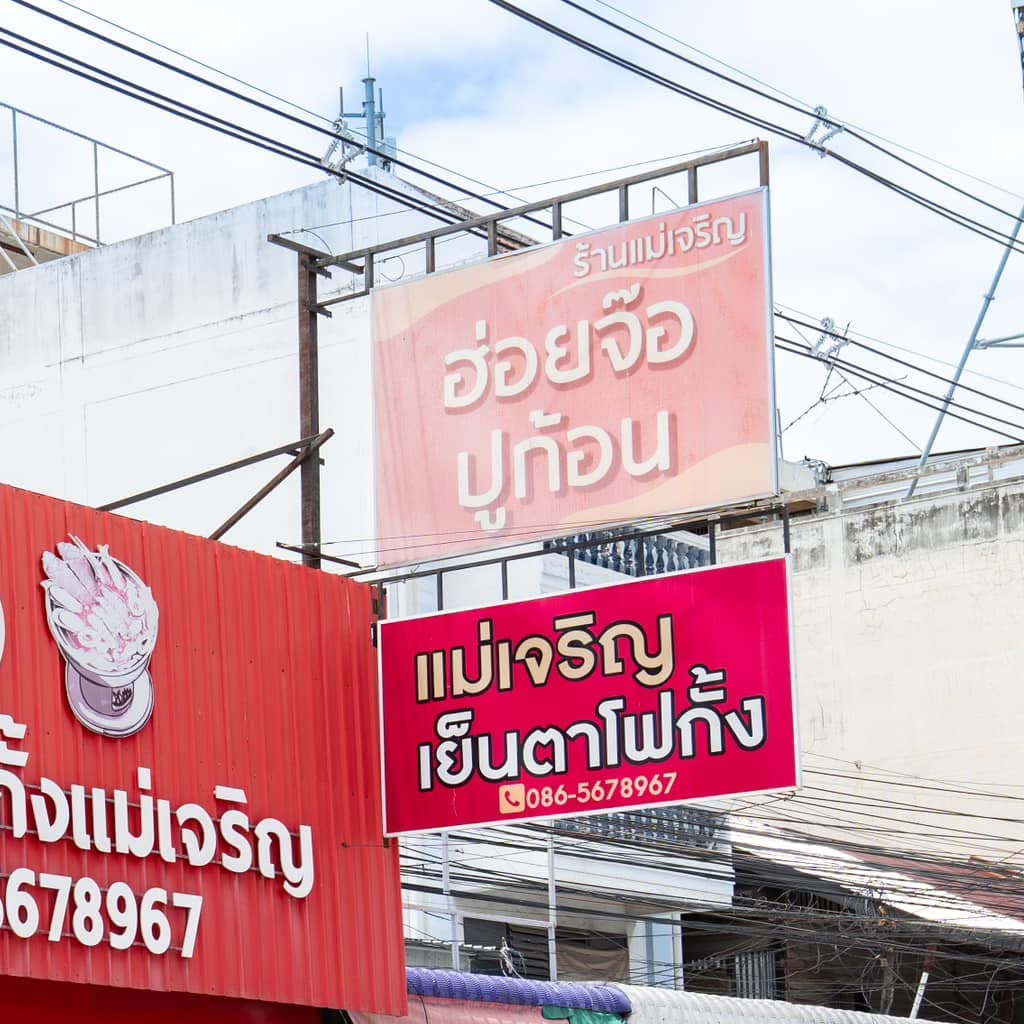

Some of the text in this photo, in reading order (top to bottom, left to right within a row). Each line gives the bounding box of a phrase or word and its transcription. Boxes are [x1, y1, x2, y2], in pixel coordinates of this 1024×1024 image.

[574, 212, 747, 278] ร้านแม่เจริญ
[443, 283, 695, 409] ฮ่อยจ๊อ
[457, 409, 671, 531] ปูก้อน
[415, 611, 675, 703] แม่เจริญ
[418, 664, 768, 791] เย็นตาโฟกั้ง
[525, 771, 678, 810] 086-5678967
